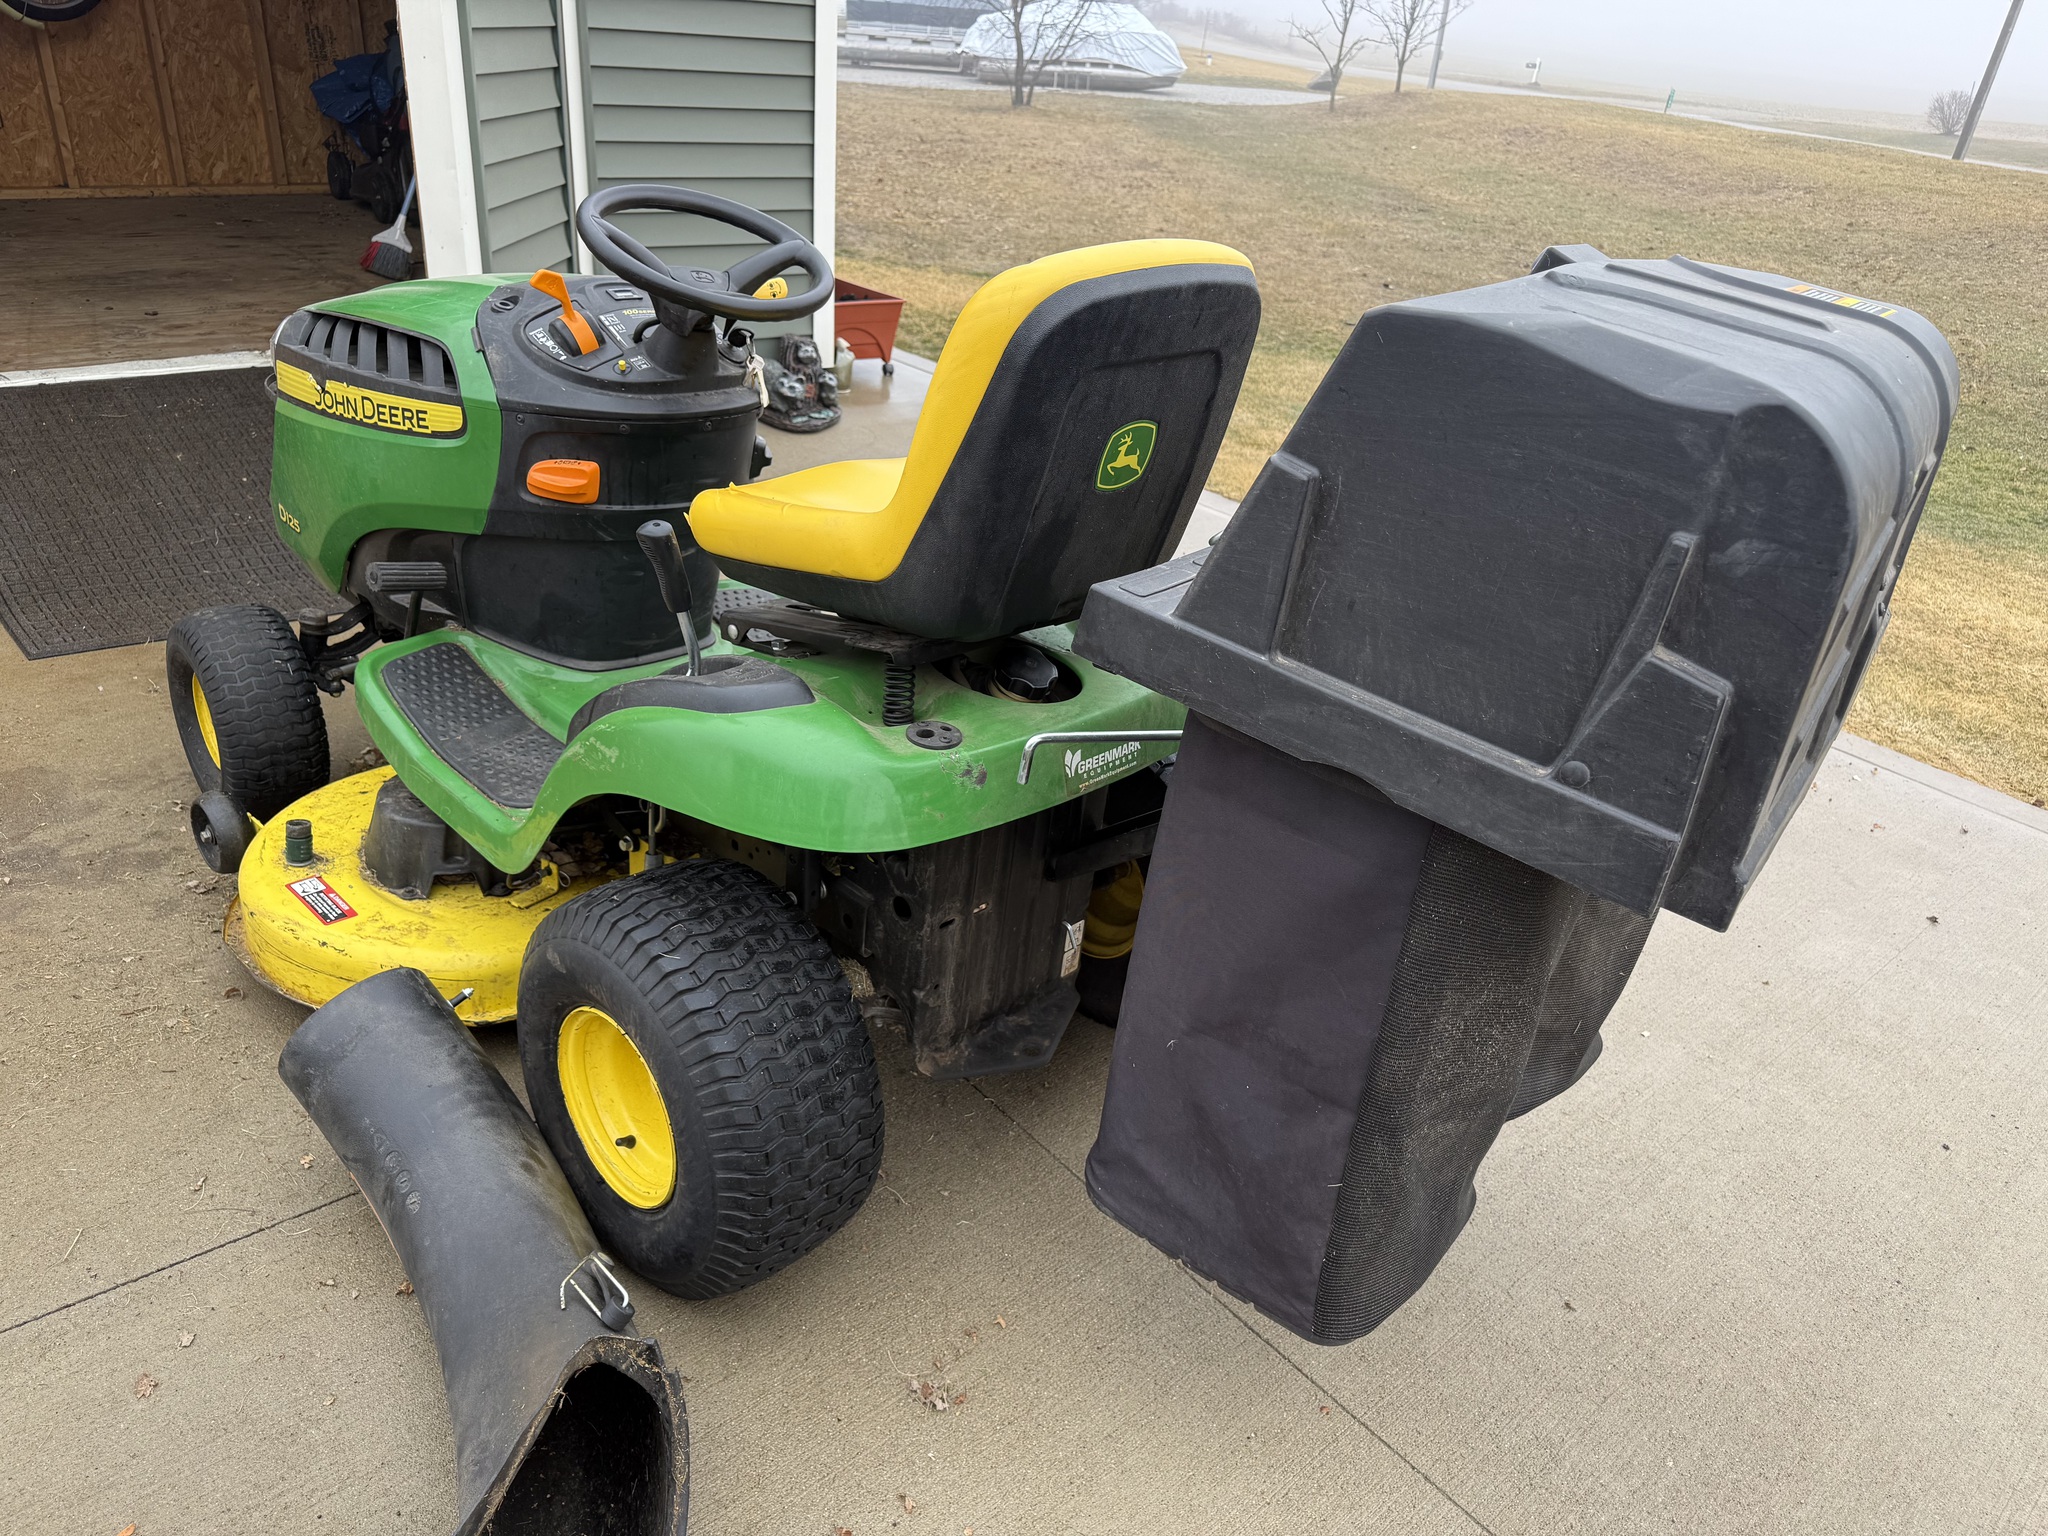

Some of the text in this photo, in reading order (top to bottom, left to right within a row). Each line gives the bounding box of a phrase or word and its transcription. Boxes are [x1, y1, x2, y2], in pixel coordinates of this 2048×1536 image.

[315, 389, 430, 430] JOHN DEERE
[278, 503, 301, 533] D125
[1077, 741, 1141, 774] GREENMARK
[1083, 752, 1137, 779] EQUIPMENT
